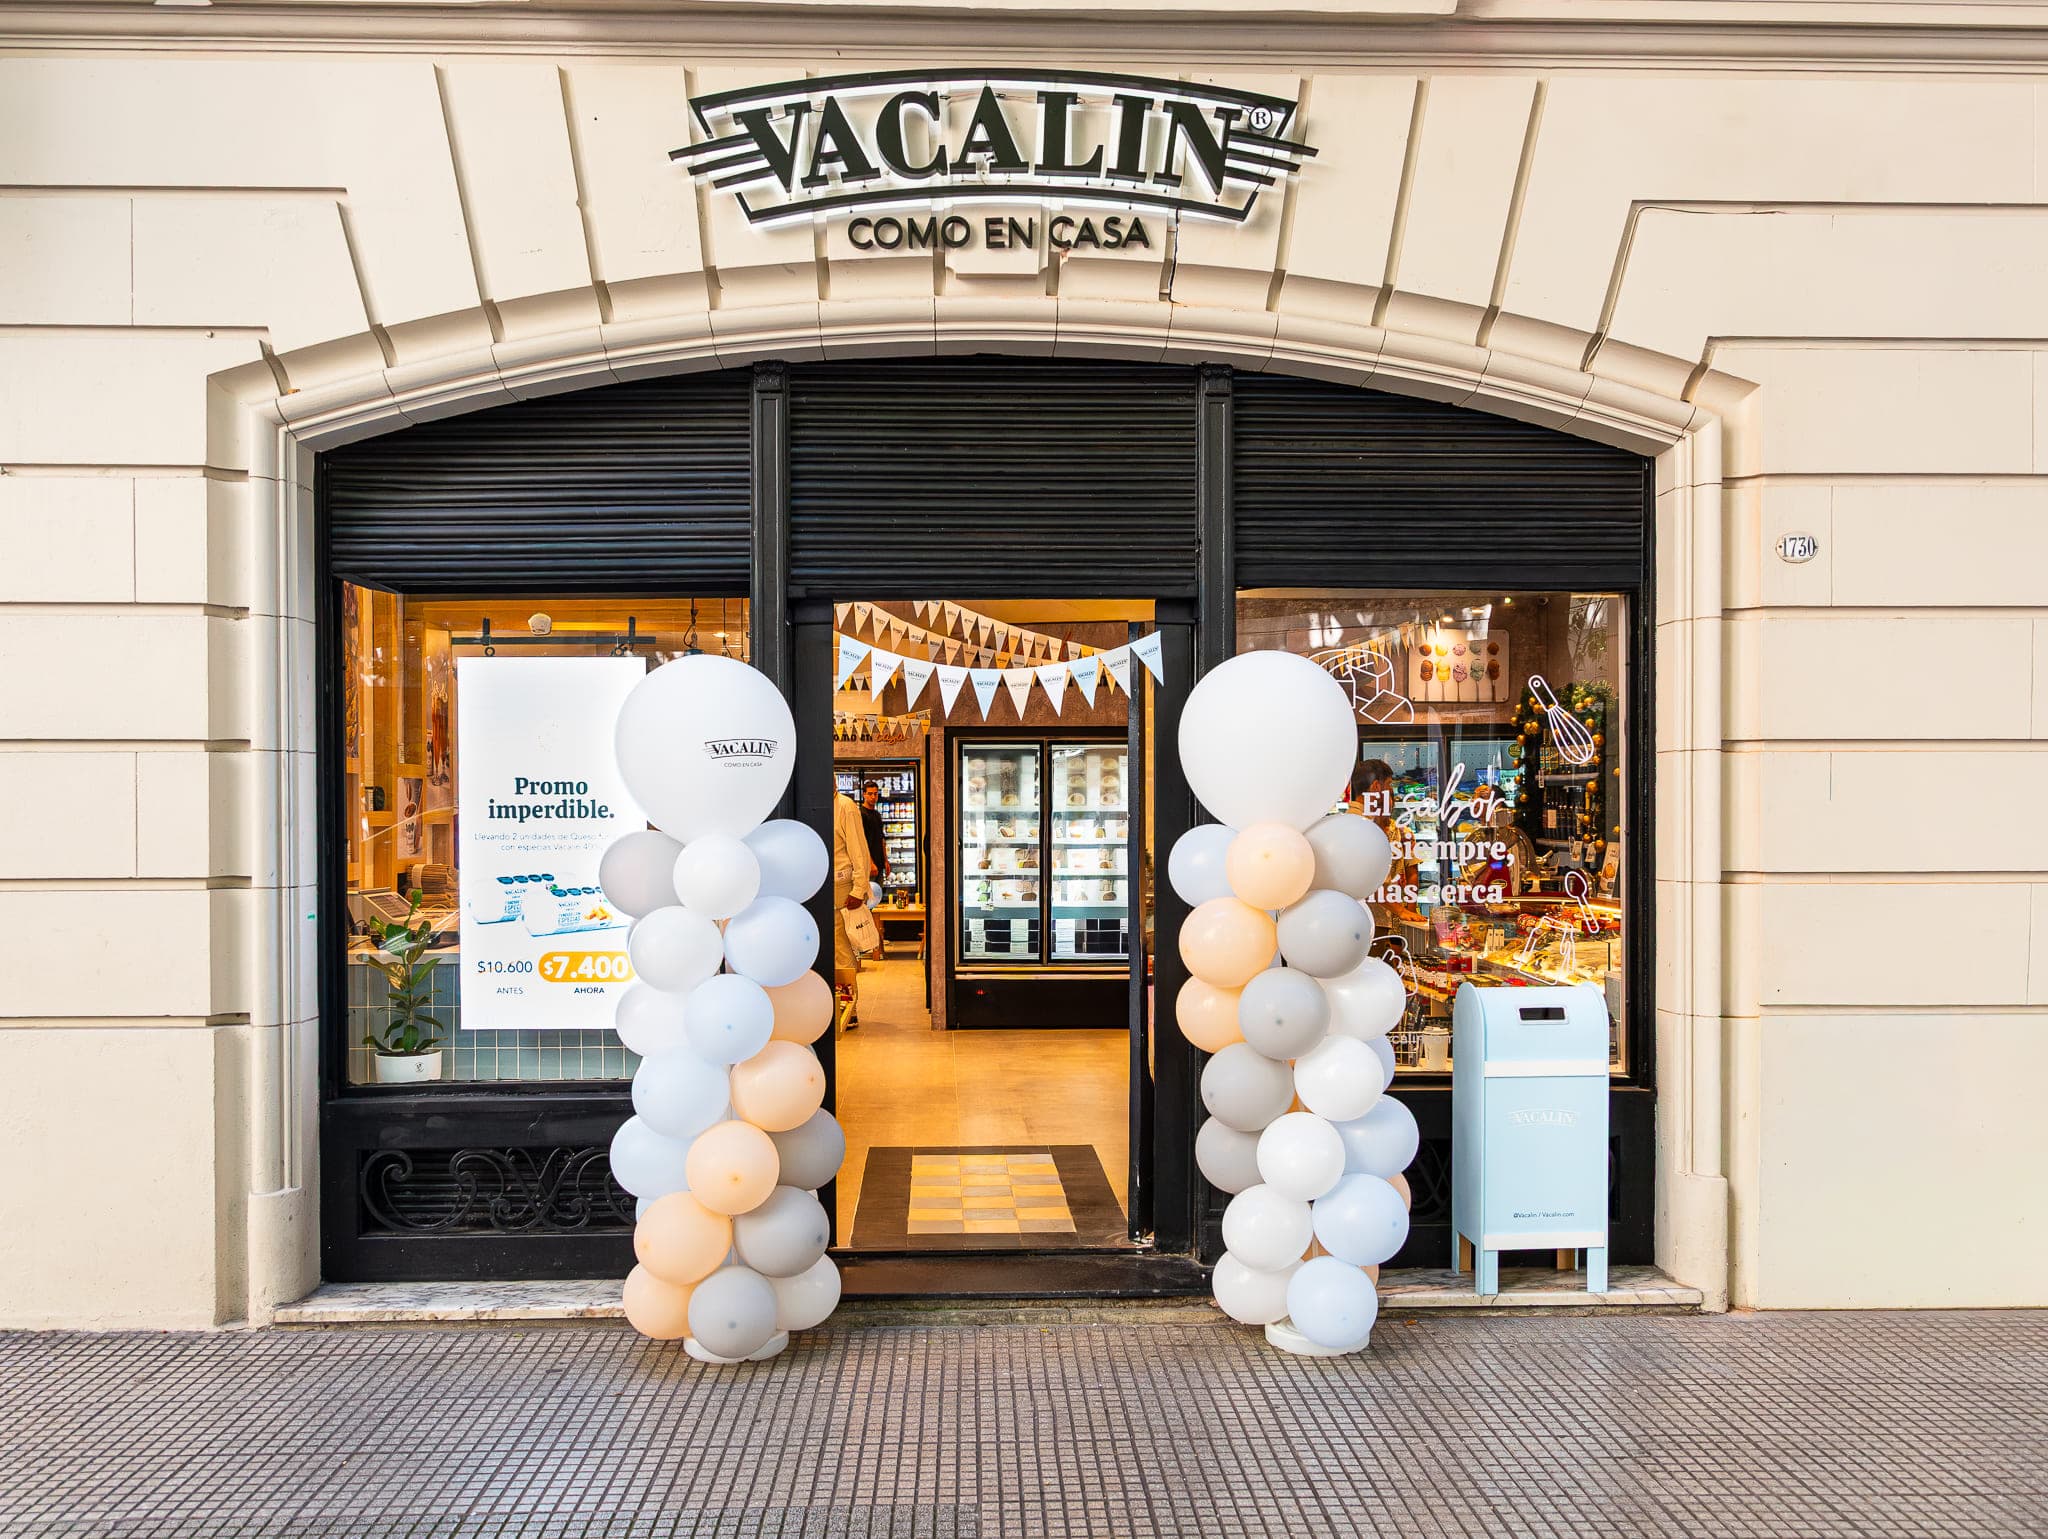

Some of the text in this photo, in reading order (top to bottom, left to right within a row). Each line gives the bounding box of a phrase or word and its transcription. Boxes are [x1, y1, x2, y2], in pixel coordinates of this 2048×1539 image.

[733, 86, 1243, 196] VACALIN
[848, 216, 1150, 250] COMO EN CASA
[1783, 536, 1815, 558] 1730
[712, 741, 772, 755] VACALIN
[514, 777, 588, 795] Promo
[1361, 763, 1506, 828] El sabor
[488, 799, 615, 823] imperdible.
[512, 832, 518, 841] 2
[1391, 833, 1515, 867] siempre,
[1427, 882, 1504, 904] cerca
[477, 956, 629, 979] $10.600 $7.400
[496, 987, 605, 995] ANTES AHORA
